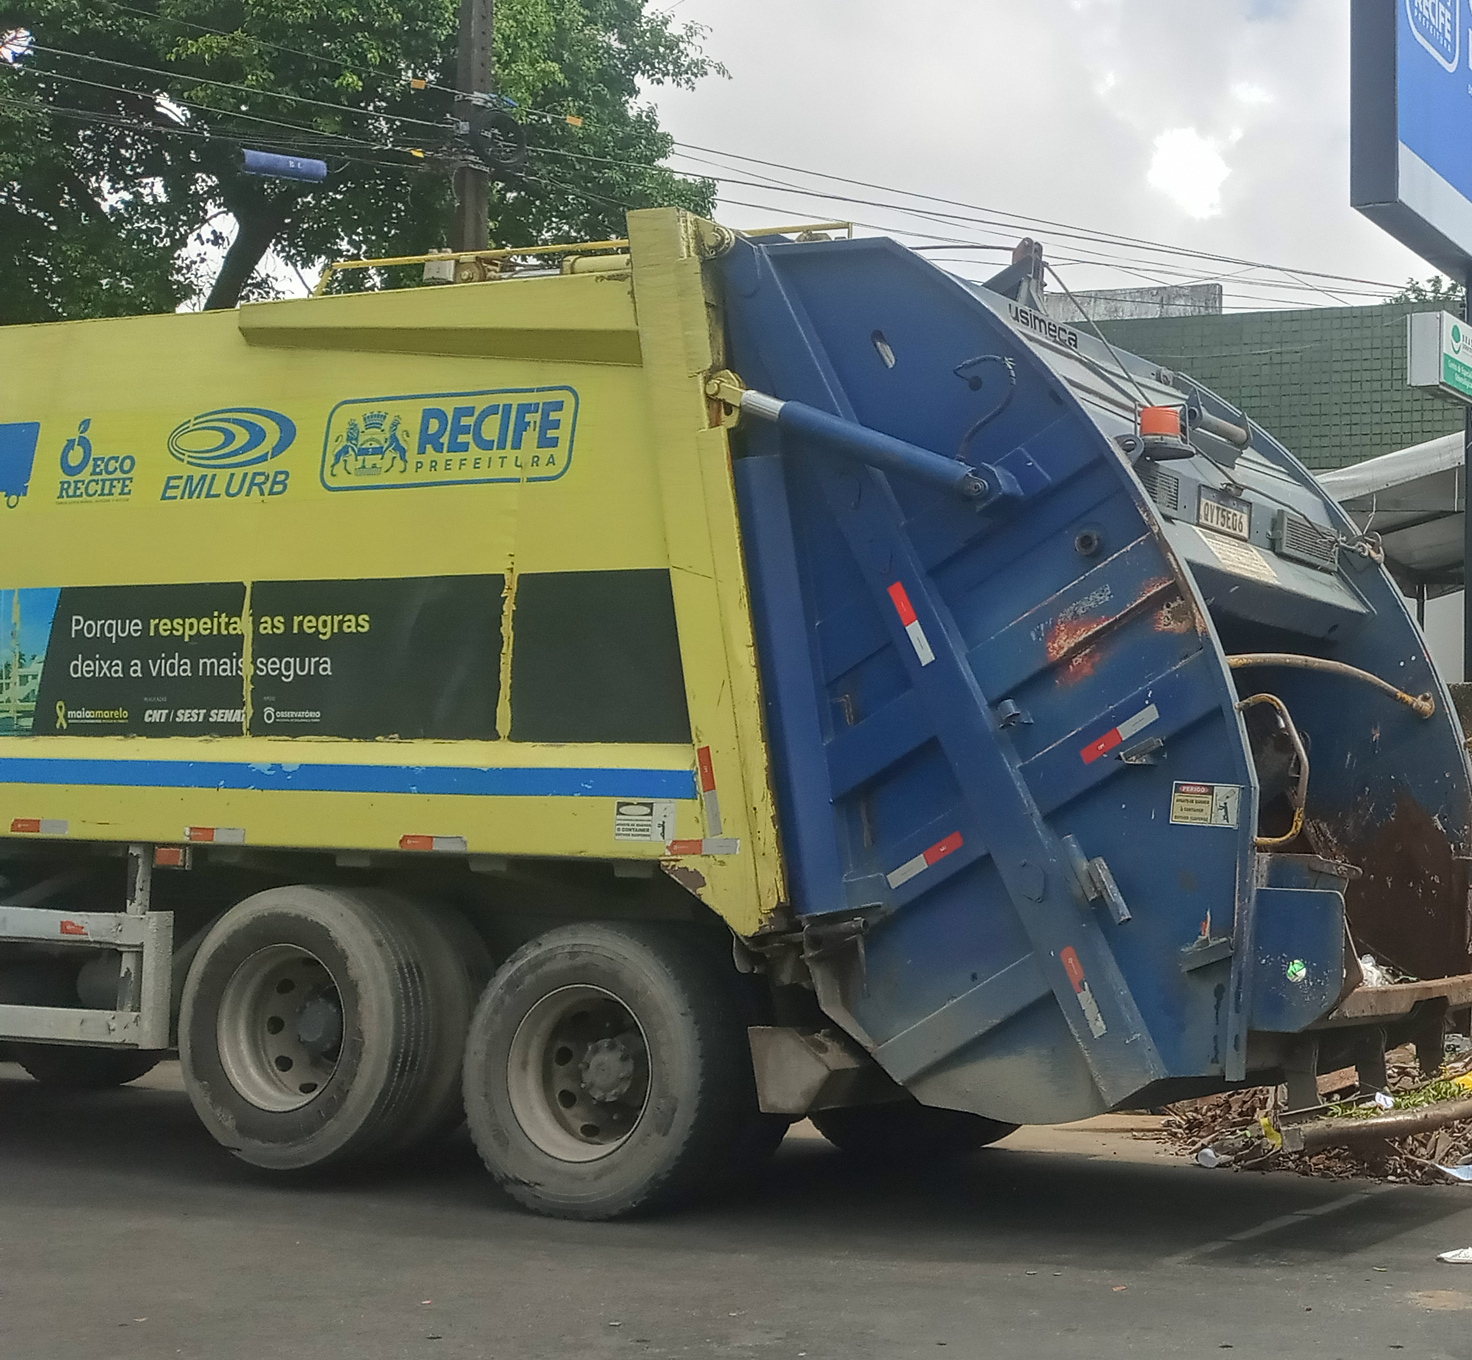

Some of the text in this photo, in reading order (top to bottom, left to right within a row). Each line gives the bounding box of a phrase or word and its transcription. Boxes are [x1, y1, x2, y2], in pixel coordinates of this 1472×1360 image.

[1414, 0, 1452, 43] ECIFE
[1008, 303, 1078, 350] usimeca
[417, 400, 565, 455] RECIFE
[90, 455, 136, 476] ECO
[415, 454, 557, 473] PREFEITURA
[57, 477, 134, 499] RECIFE
[160, 470, 290, 501] EMLURB
[71, 609, 370, 643] Porque respeita as regras
[70, 654, 123, 678] deixa
[129, 659, 143, 678] a
[149, 652, 192, 677] vida
[256, 657, 332, 682] segura
[144, 709, 169, 723] CNT
[175, 709, 207, 722] SEST
